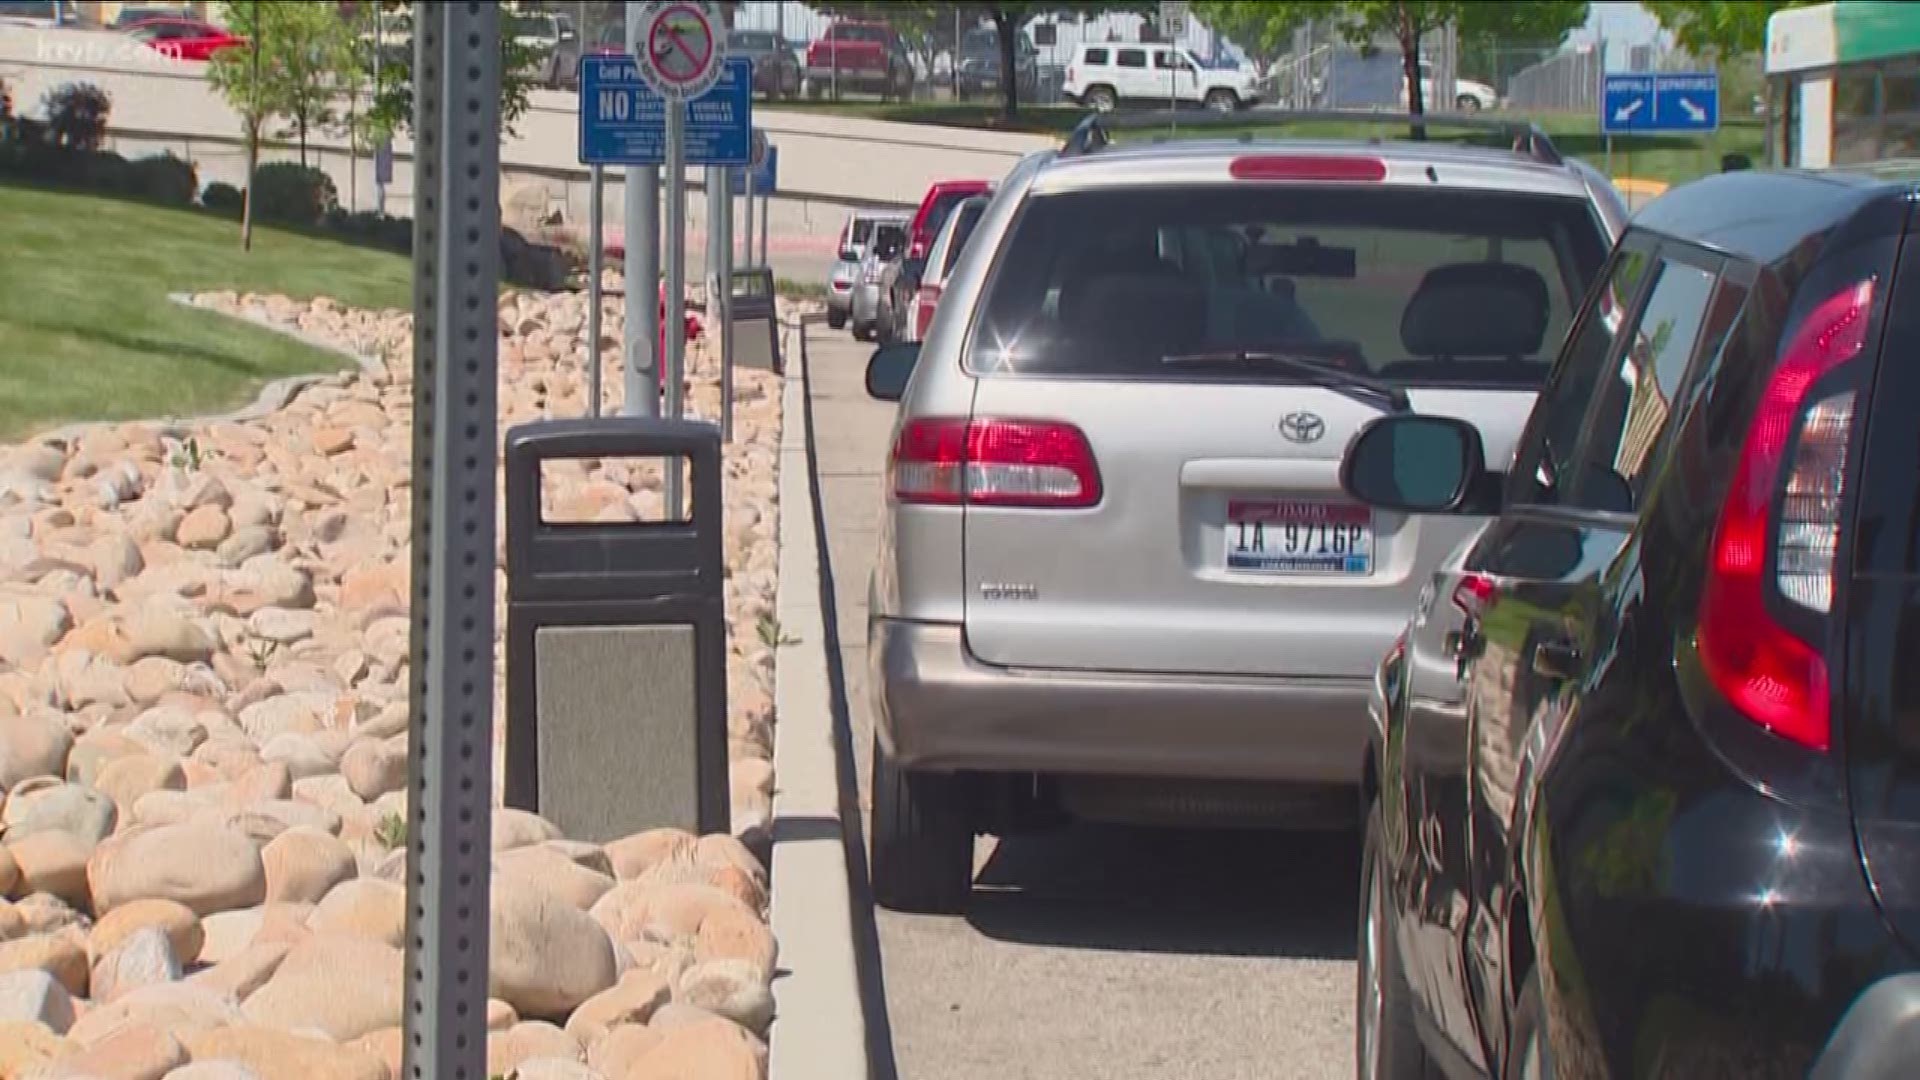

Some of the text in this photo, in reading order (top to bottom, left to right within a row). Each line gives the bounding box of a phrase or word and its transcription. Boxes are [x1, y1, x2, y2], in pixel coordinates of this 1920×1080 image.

[1166, 18, 1183, 32] 15
[598, 90, 630, 121] NO
[1236, 521, 1362, 555] 1A 9716P
